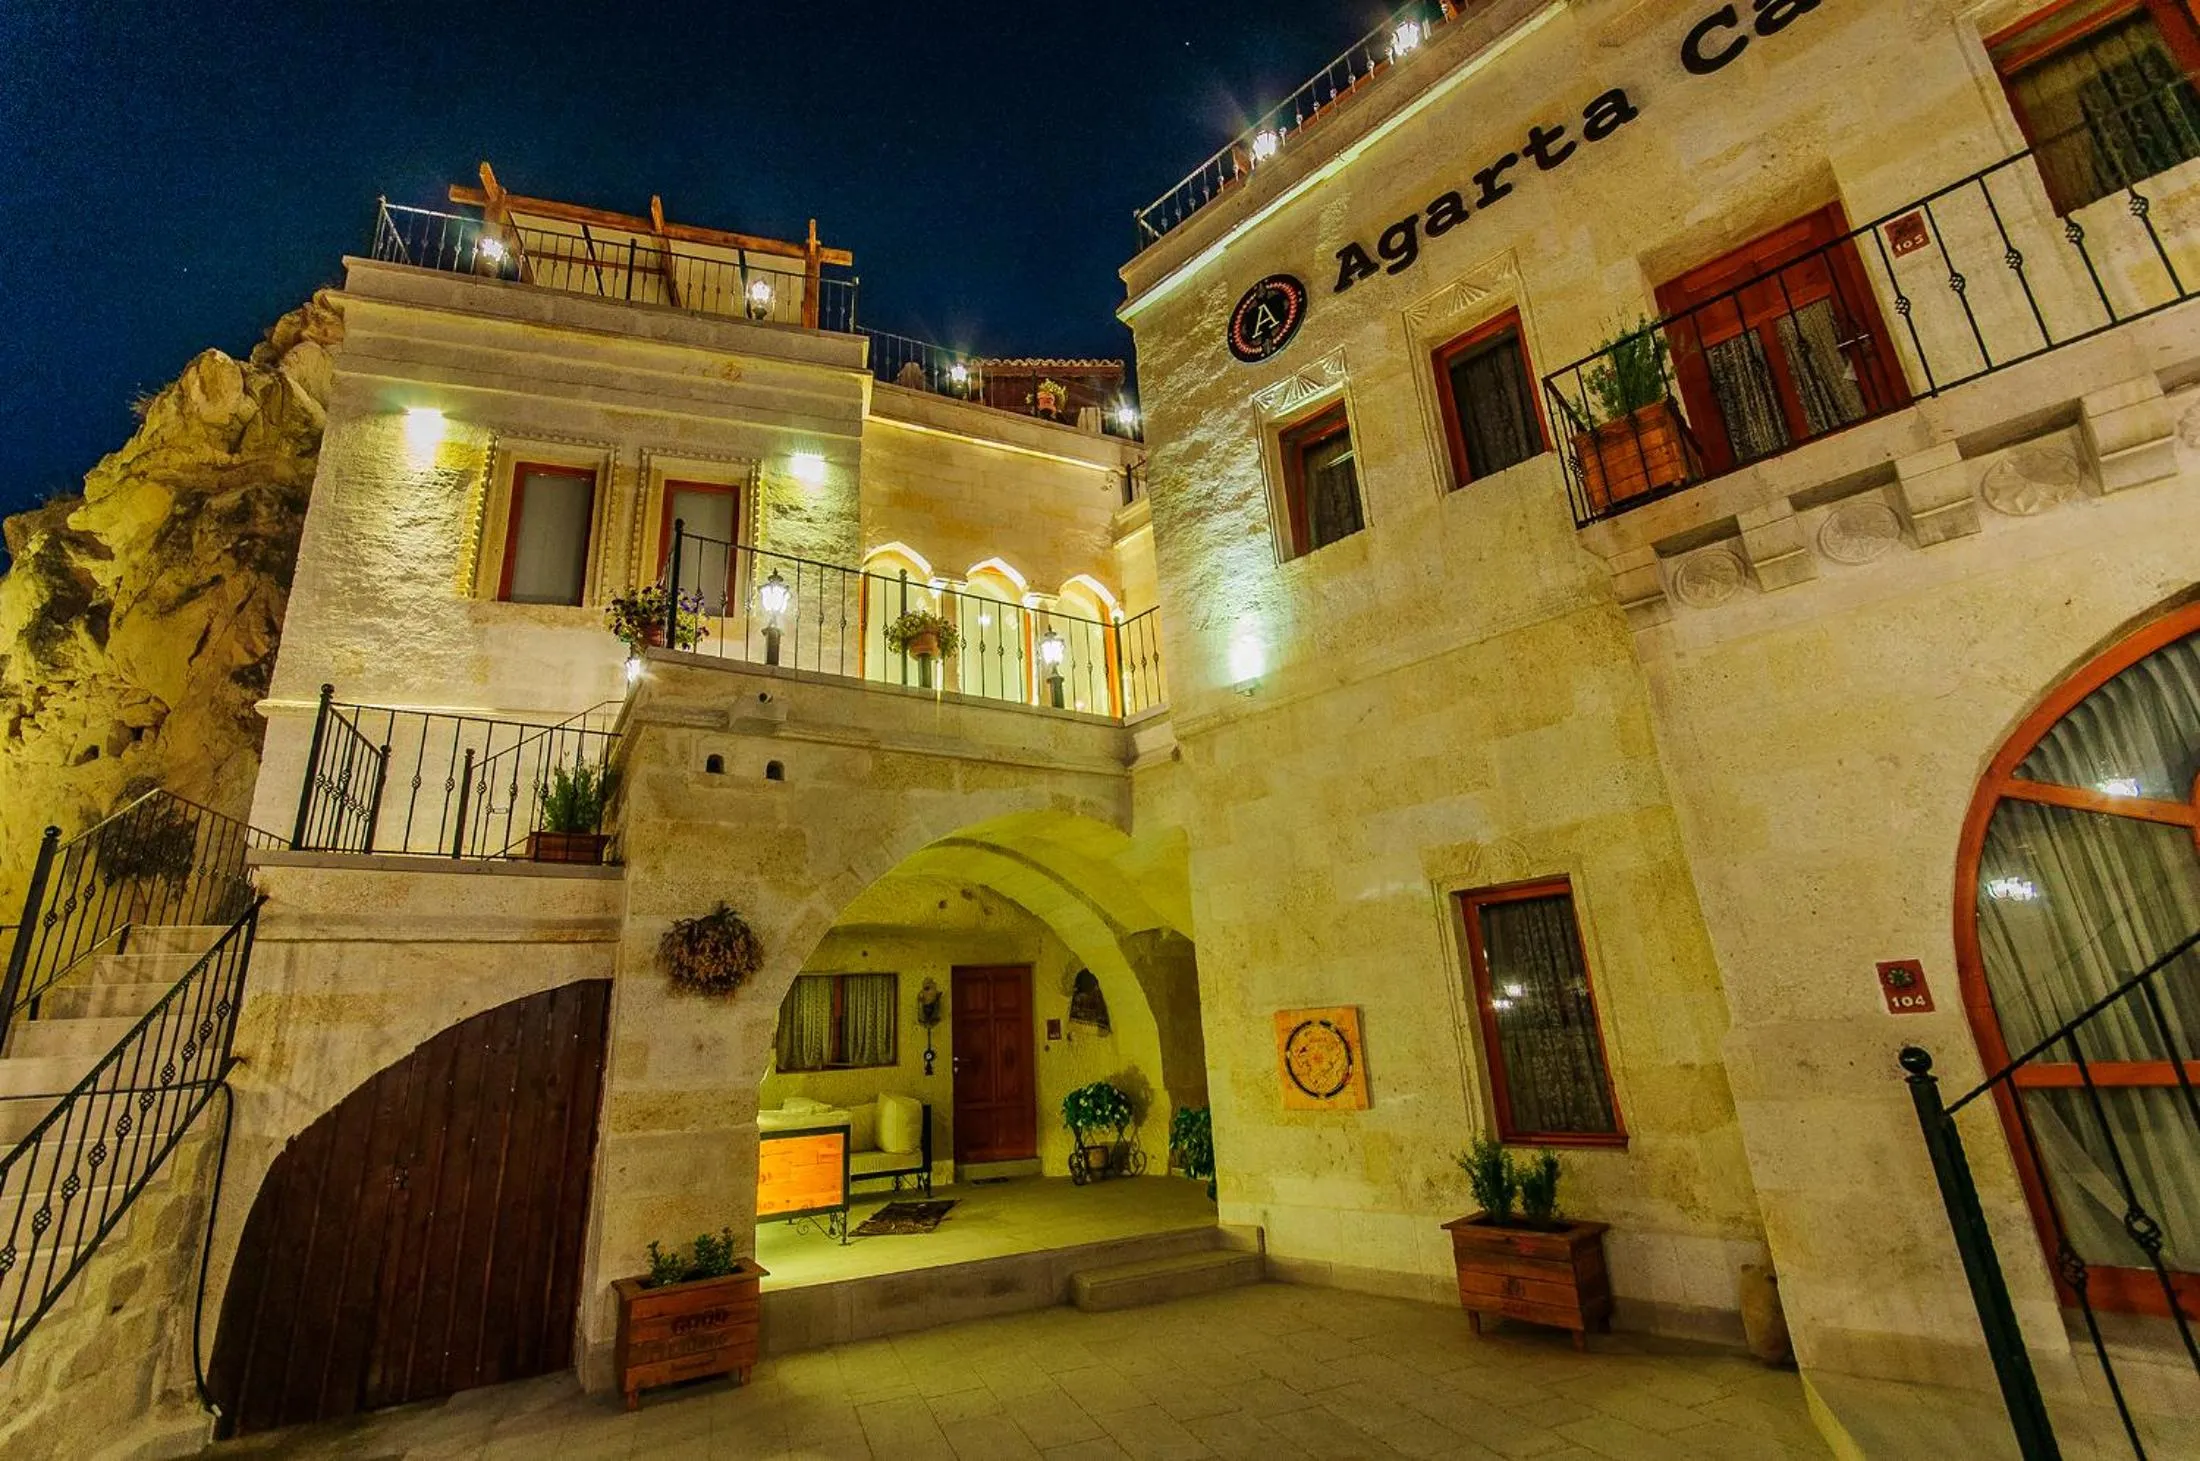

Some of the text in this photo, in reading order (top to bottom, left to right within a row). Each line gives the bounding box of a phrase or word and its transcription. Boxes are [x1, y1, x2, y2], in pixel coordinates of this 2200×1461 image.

[1333, 88, 1640, 294] Agarta
[1896, 234, 1924, 252] 105
[1251, 303, 1280, 339] A
[1892, 994, 1926, 1008] 104
